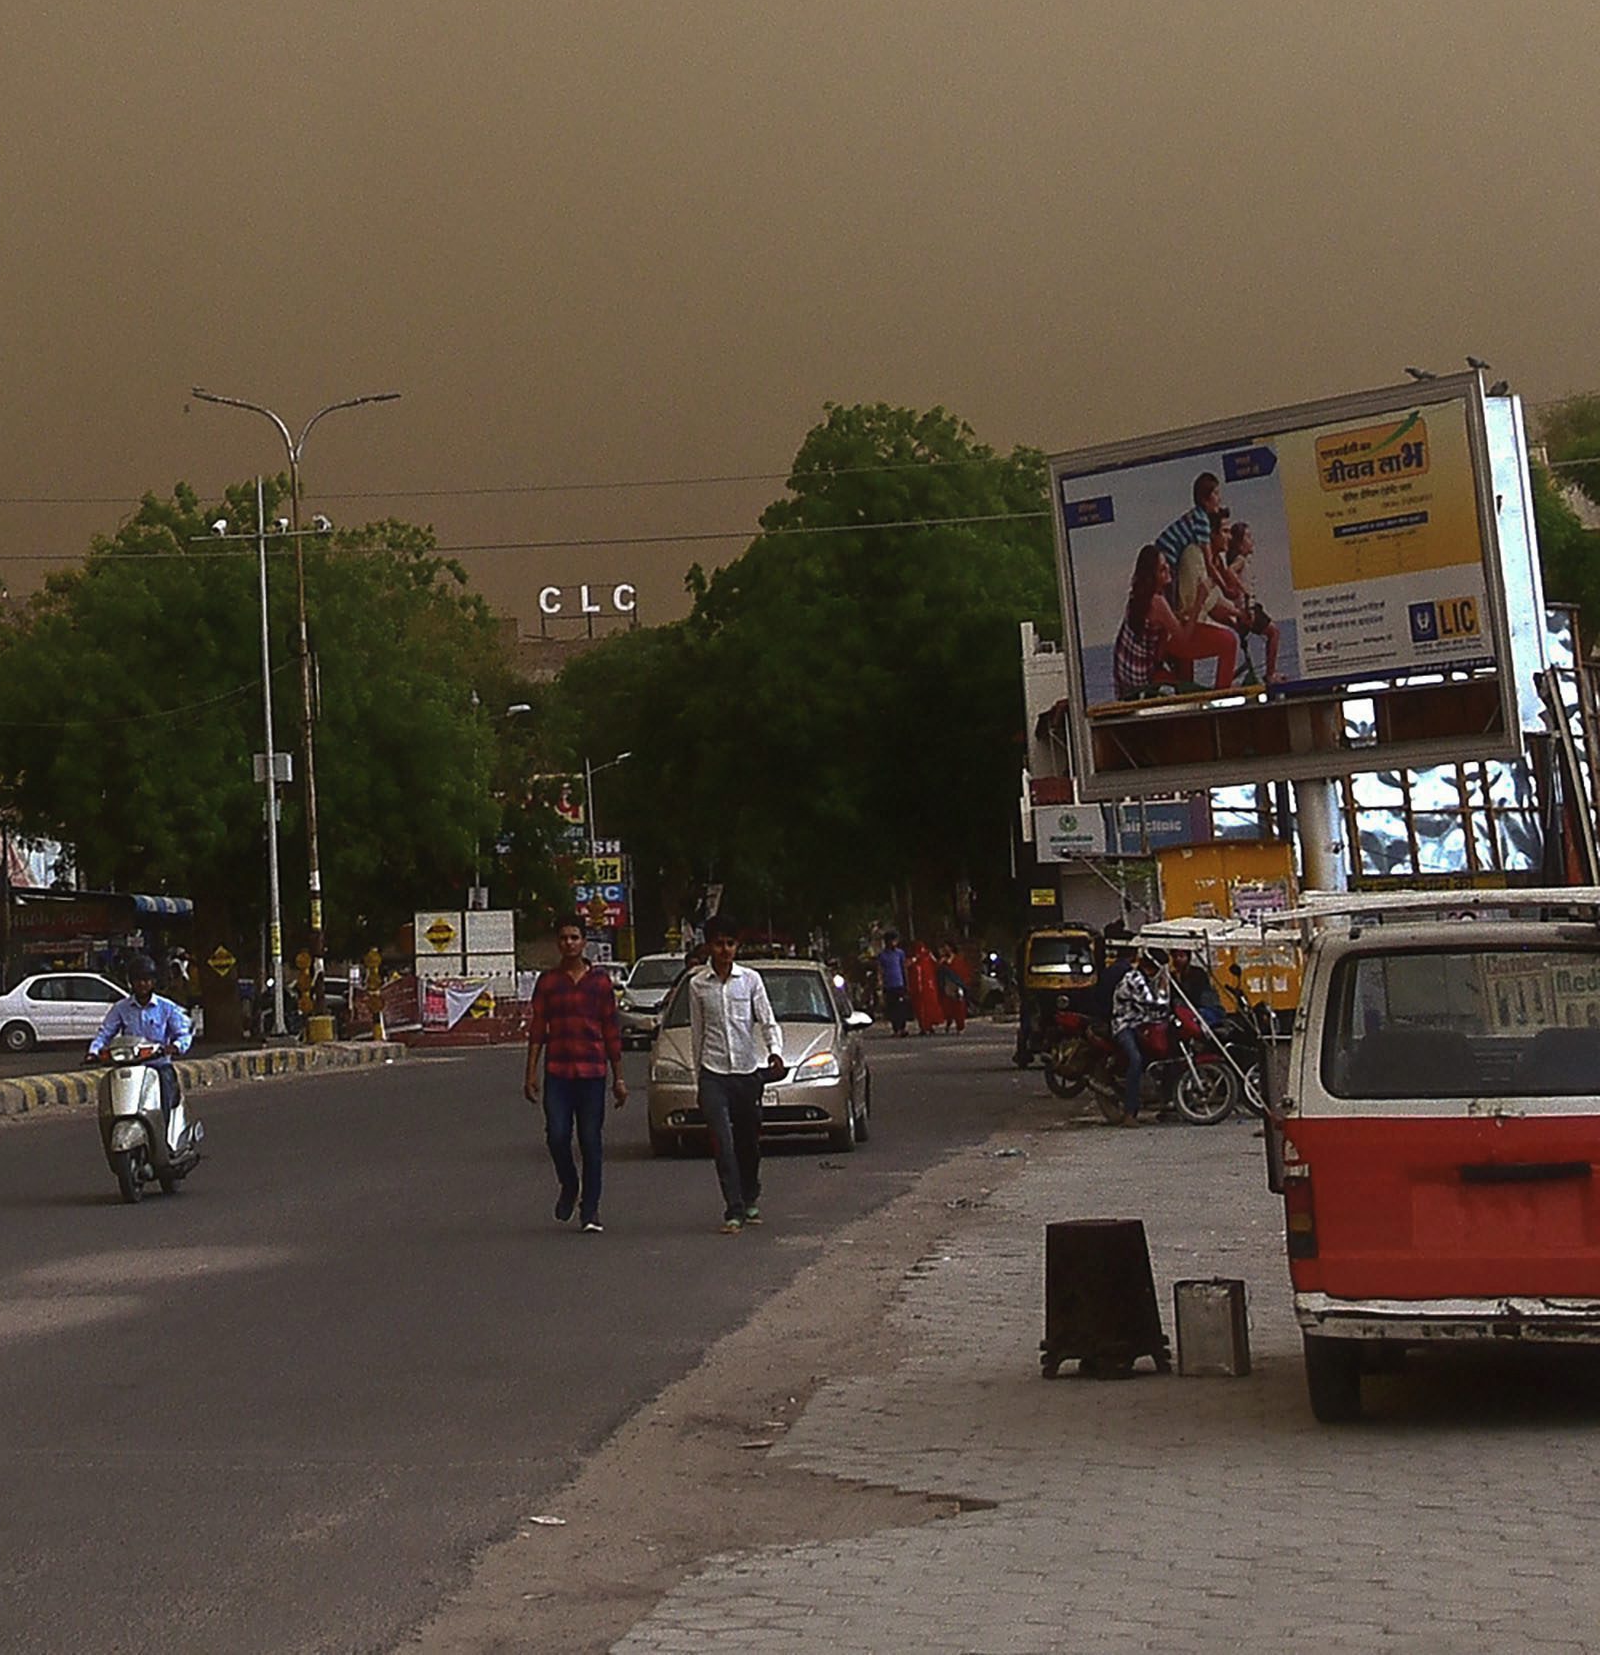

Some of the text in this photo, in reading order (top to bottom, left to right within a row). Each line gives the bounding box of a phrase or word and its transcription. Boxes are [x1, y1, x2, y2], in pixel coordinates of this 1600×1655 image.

[1323, 441, 1424, 483] जीवन लाभ
[1439, 600, 1475, 635] LIC
